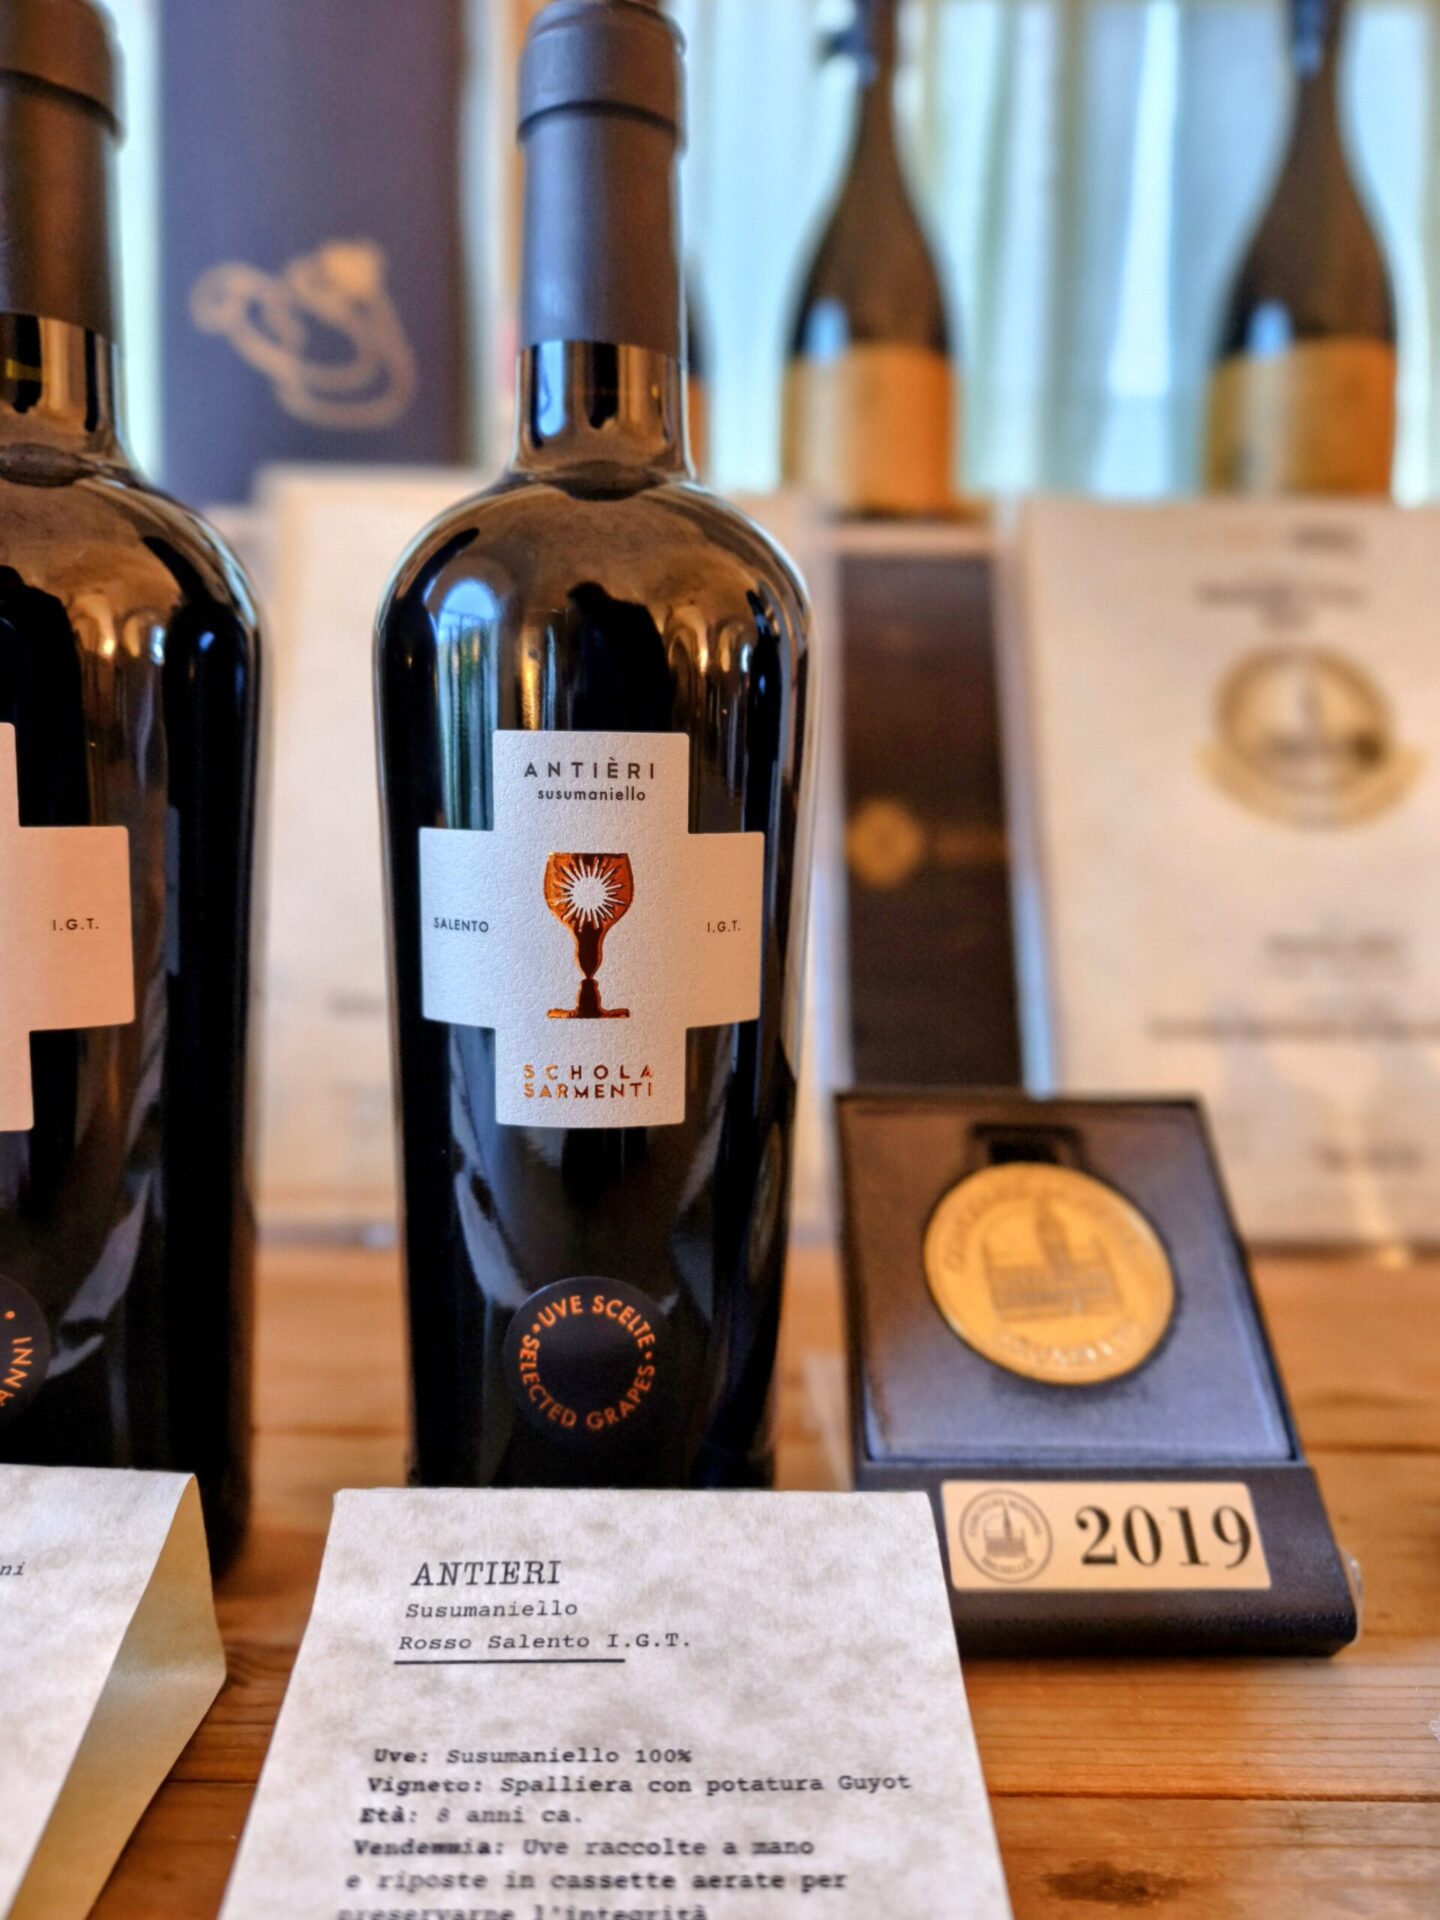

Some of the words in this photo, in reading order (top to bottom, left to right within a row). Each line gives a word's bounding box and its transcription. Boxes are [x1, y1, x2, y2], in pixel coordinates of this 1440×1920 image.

[524, 757, 654, 779] ANTIÈRI
[538, 786, 646, 801] susumaniello
[52, 918, 100, 931] I.G.T.
[433, 917, 489, 933] SALENTO
[707, 920, 741, 933] I.G.T.
[523, 1064, 653, 1080] SCHOLA
[523, 1082, 653, 1099] SARMENTI
[538, 1296, 584, 1328] UVE
[592, 1295, 656, 1349] SCELTE
[519, 1334, 577, 1428] SELECTED
[586, 1365, 656, 1430] GRAPES
[1075, 1505, 1252, 1569] 2019
[409, 1559, 563, 1587] ANTIERI
[404, 1599, 578, 1619] Susumaniello
[397, 1635, 473, 1651] Rosso
[487, 1633, 591, 1650] Salento
[606, 1631, 690, 1649] I.G.T.
[373, 1748, 429, 1764] Uve:
[445, 1745, 620, 1765] Susumaniello
[634, 1748, 693, 1764] 100%
[367, 1775, 483, 1798] Vigneto:
[499, 1775, 634, 1798] Spalliera
[646, 1779, 693, 1794] con
[704, 1776, 825, 1798] potatura
[837, 1774, 913, 1795] Guyot
[465, 1805, 526, 1825] anni
[540, 1809, 582, 1824] ca.
[353, 1837, 504, 1857] Vendemmia:
[522, 1837, 570, 1857] Uve
[583, 1836, 709, 1858] raccolte
[721, 1841, 740, 1857] a
[750, 1840, 816, 1856] mano
[345, 1874, 362, 1890] e
[376, 1870, 489, 1897] riposte
[503, 1870, 537, 1892] in
[549, 1872, 677, 1891] cassette
[690, 1872, 787, 1891] aerate
[798, 1873, 848, 1895] per
